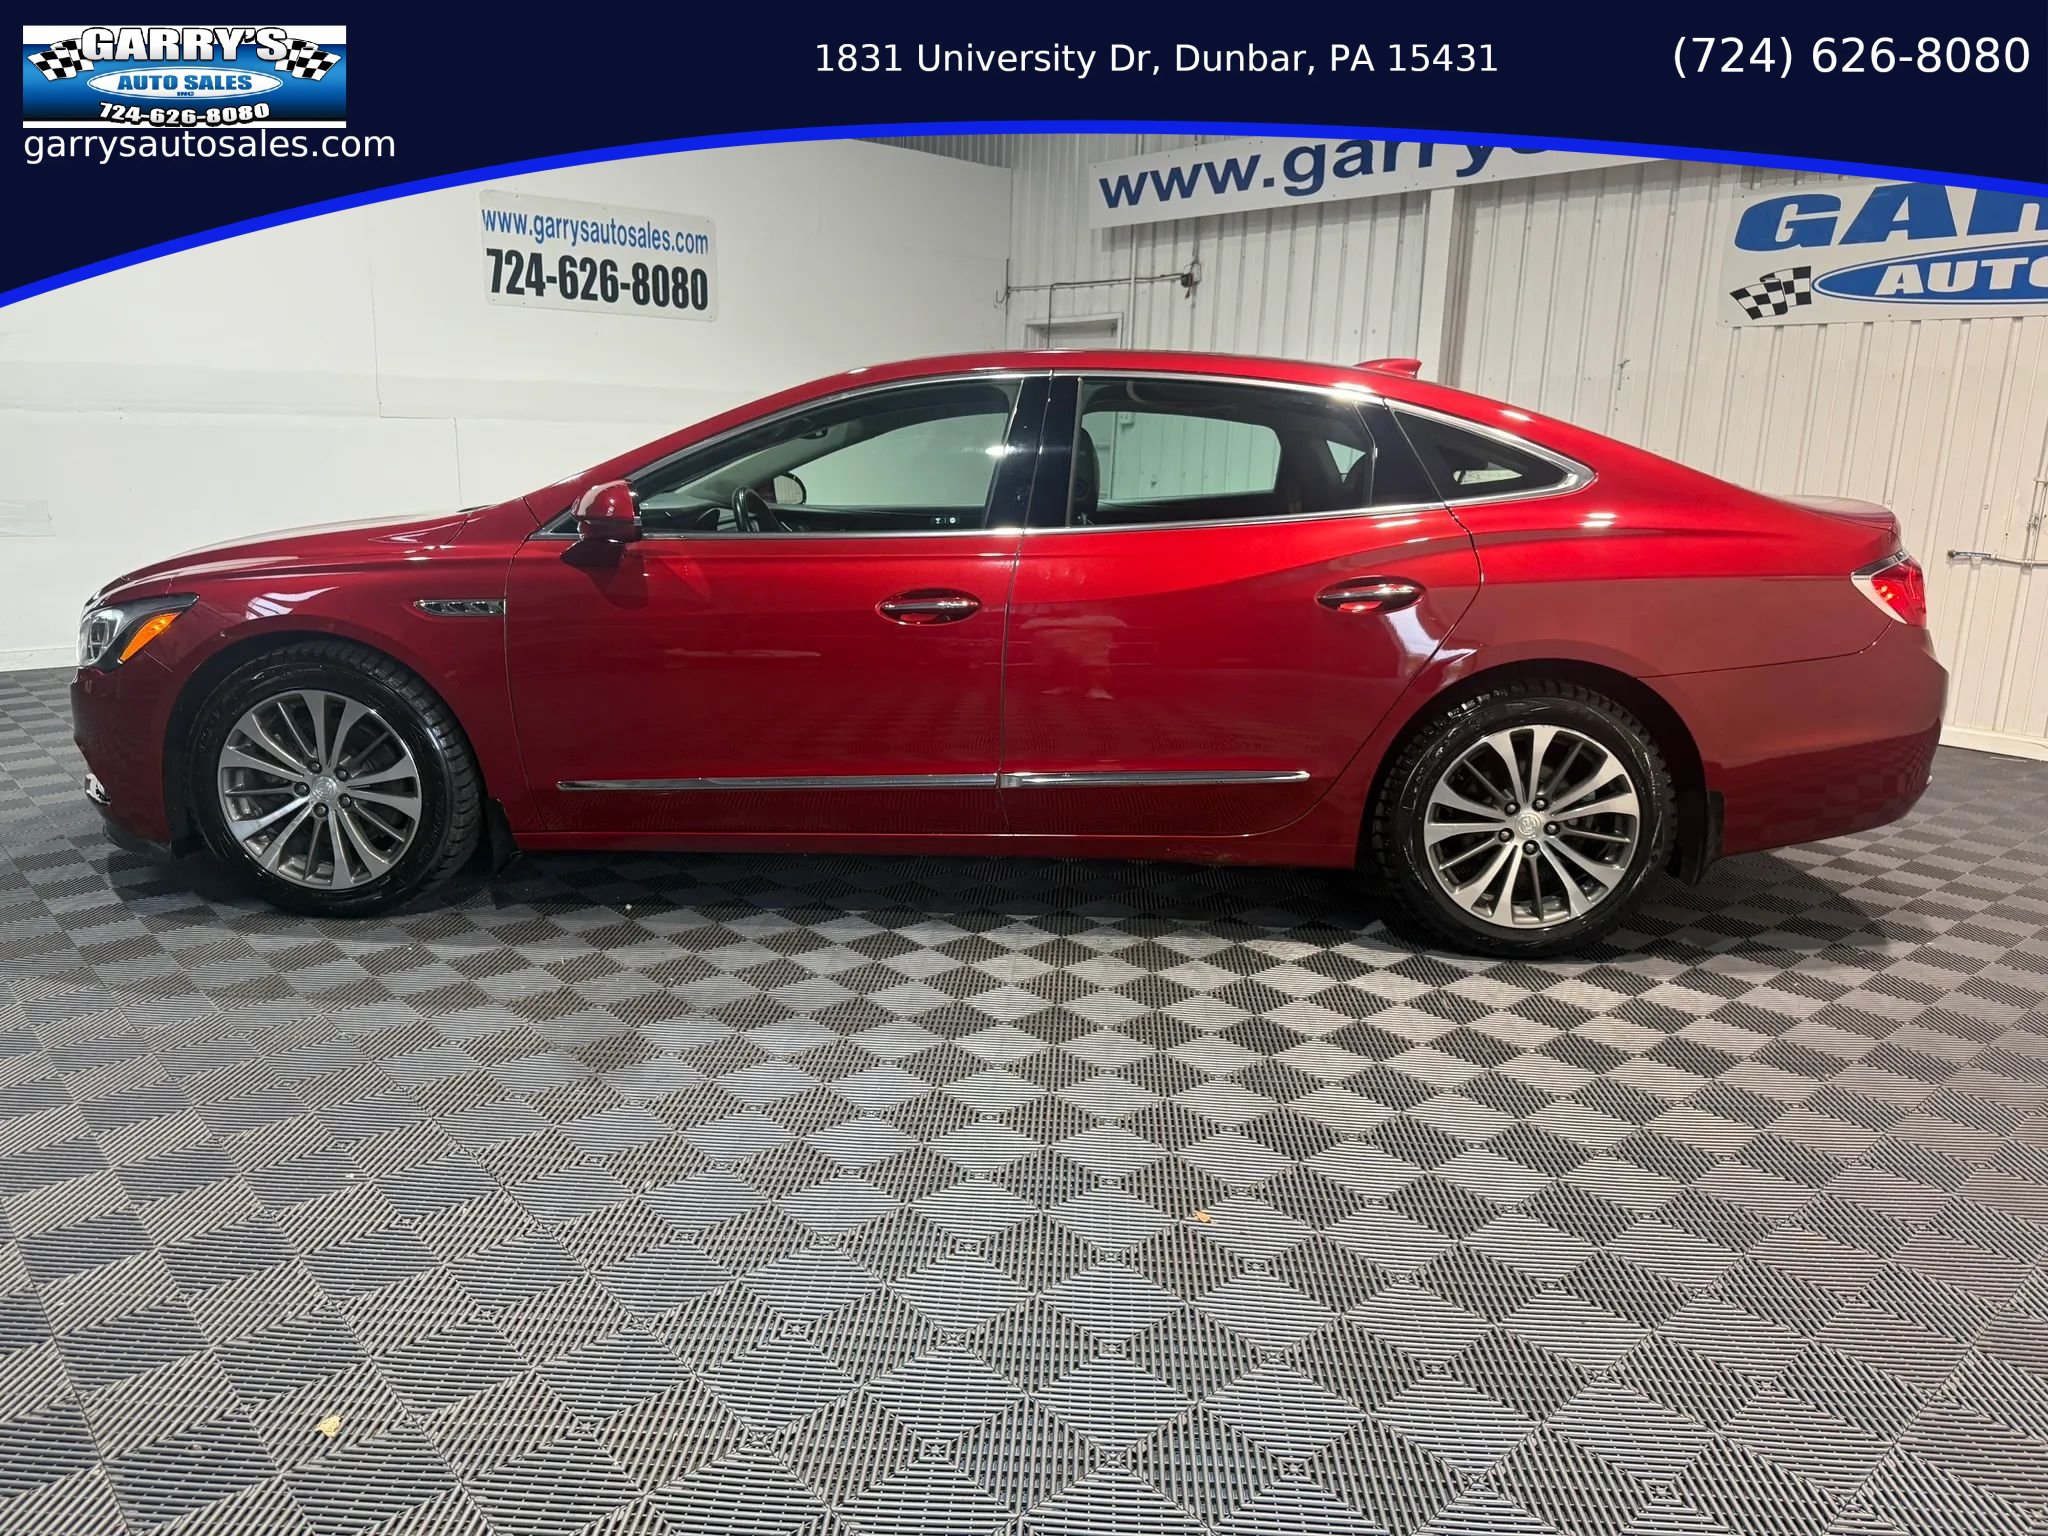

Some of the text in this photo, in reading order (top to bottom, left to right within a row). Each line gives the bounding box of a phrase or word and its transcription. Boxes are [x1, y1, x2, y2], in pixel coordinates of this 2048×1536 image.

[1099, 139, 1547, 208] www.garry
[482, 209, 708, 254] www.garrysautosales.com
[486, 247, 708, 311] 724-626-8080
